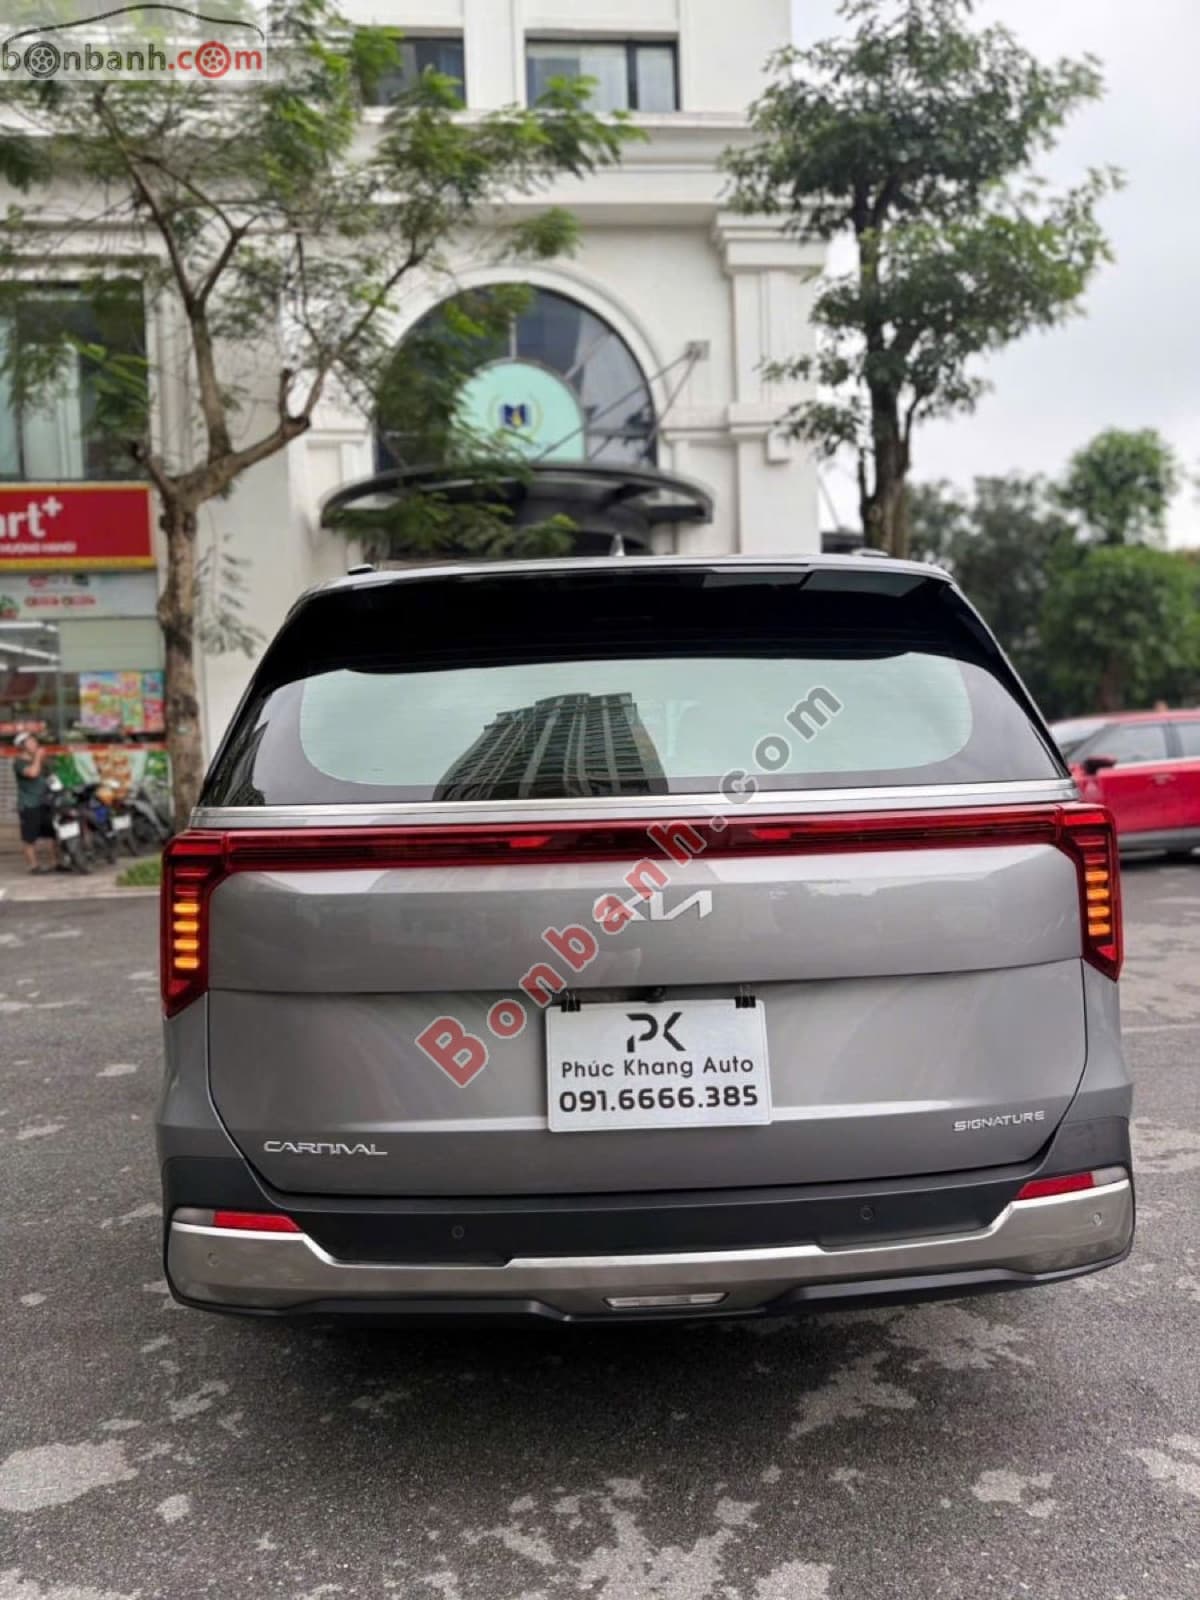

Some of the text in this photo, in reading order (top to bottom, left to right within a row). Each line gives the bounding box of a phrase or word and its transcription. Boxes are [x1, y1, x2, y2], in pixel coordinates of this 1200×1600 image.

[626, 1012, 687, 1053] PK
[562, 1055, 754, 1079] Phúc Khang Auto
[559, 1085, 758, 1113] 091.6666.385
[954, 1110, 1046, 1132] SIGNATURE
[263, 1140, 389, 1156] CARNIVAL
